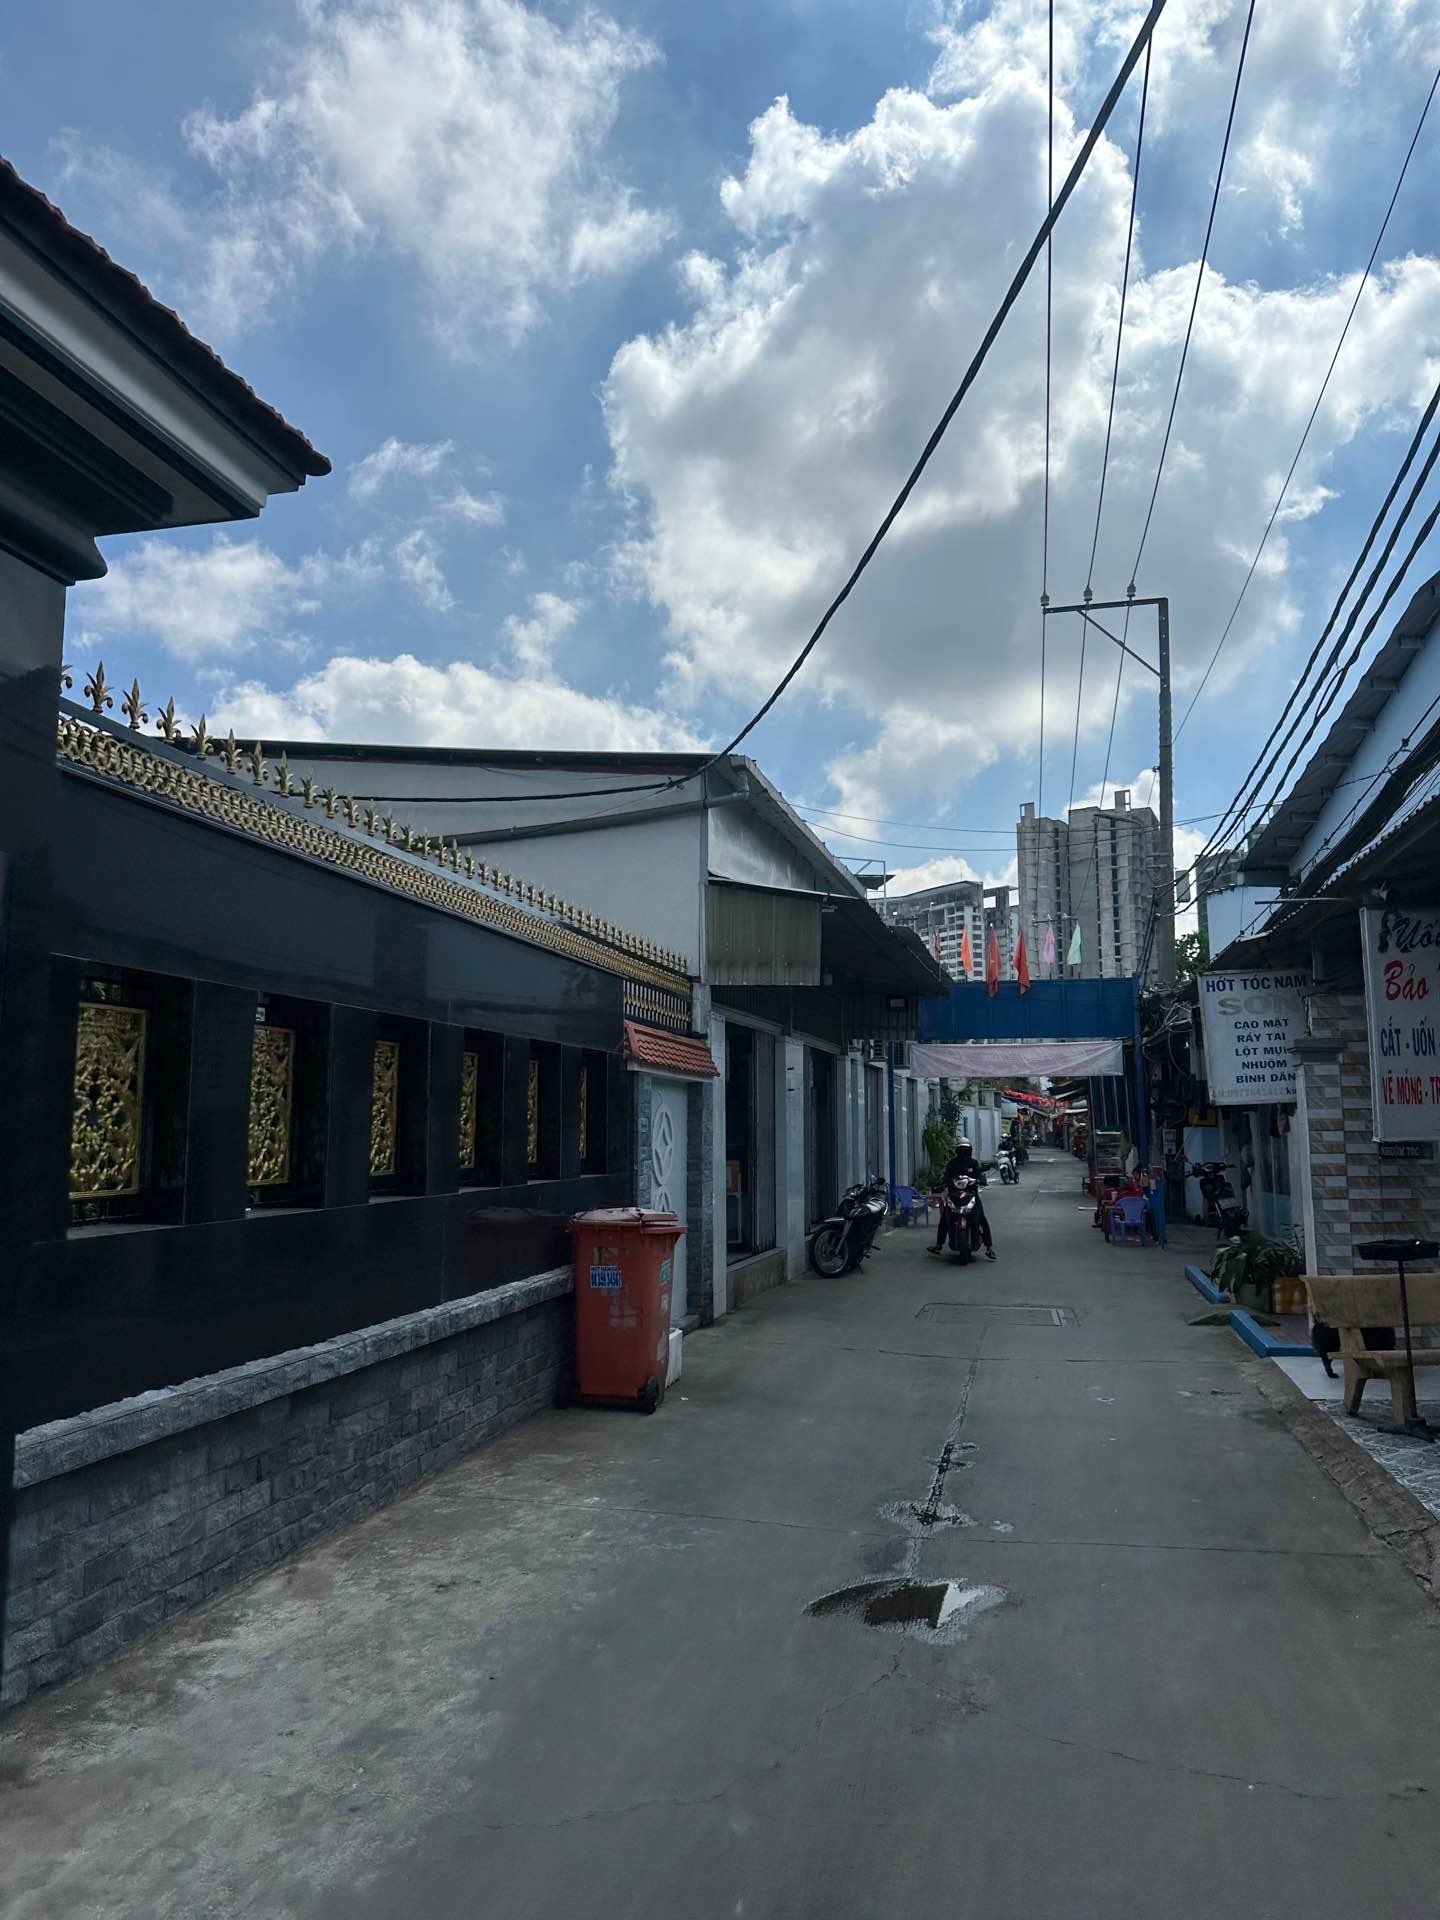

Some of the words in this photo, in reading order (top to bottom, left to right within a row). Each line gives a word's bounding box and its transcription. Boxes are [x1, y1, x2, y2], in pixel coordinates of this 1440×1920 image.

[1206, 976, 1235, 992] HỚT
[1240, 975, 1271, 990] TÓC
[1274, 975, 1306, 989] NAM
[1384, 960, 1429, 1001] Bảo
[1234, 1020, 1259, 1031] CẠO
[1265, 1032, 1286, 1041] TAI
[1380, 1016, 1401, 1056] CẮT
[1412, 1016, 1436, 1056] UỐN
[1241, 1058, 1287, 1070] NHUỘM
[1396, 1068, 1424, 1105] MÓNG
